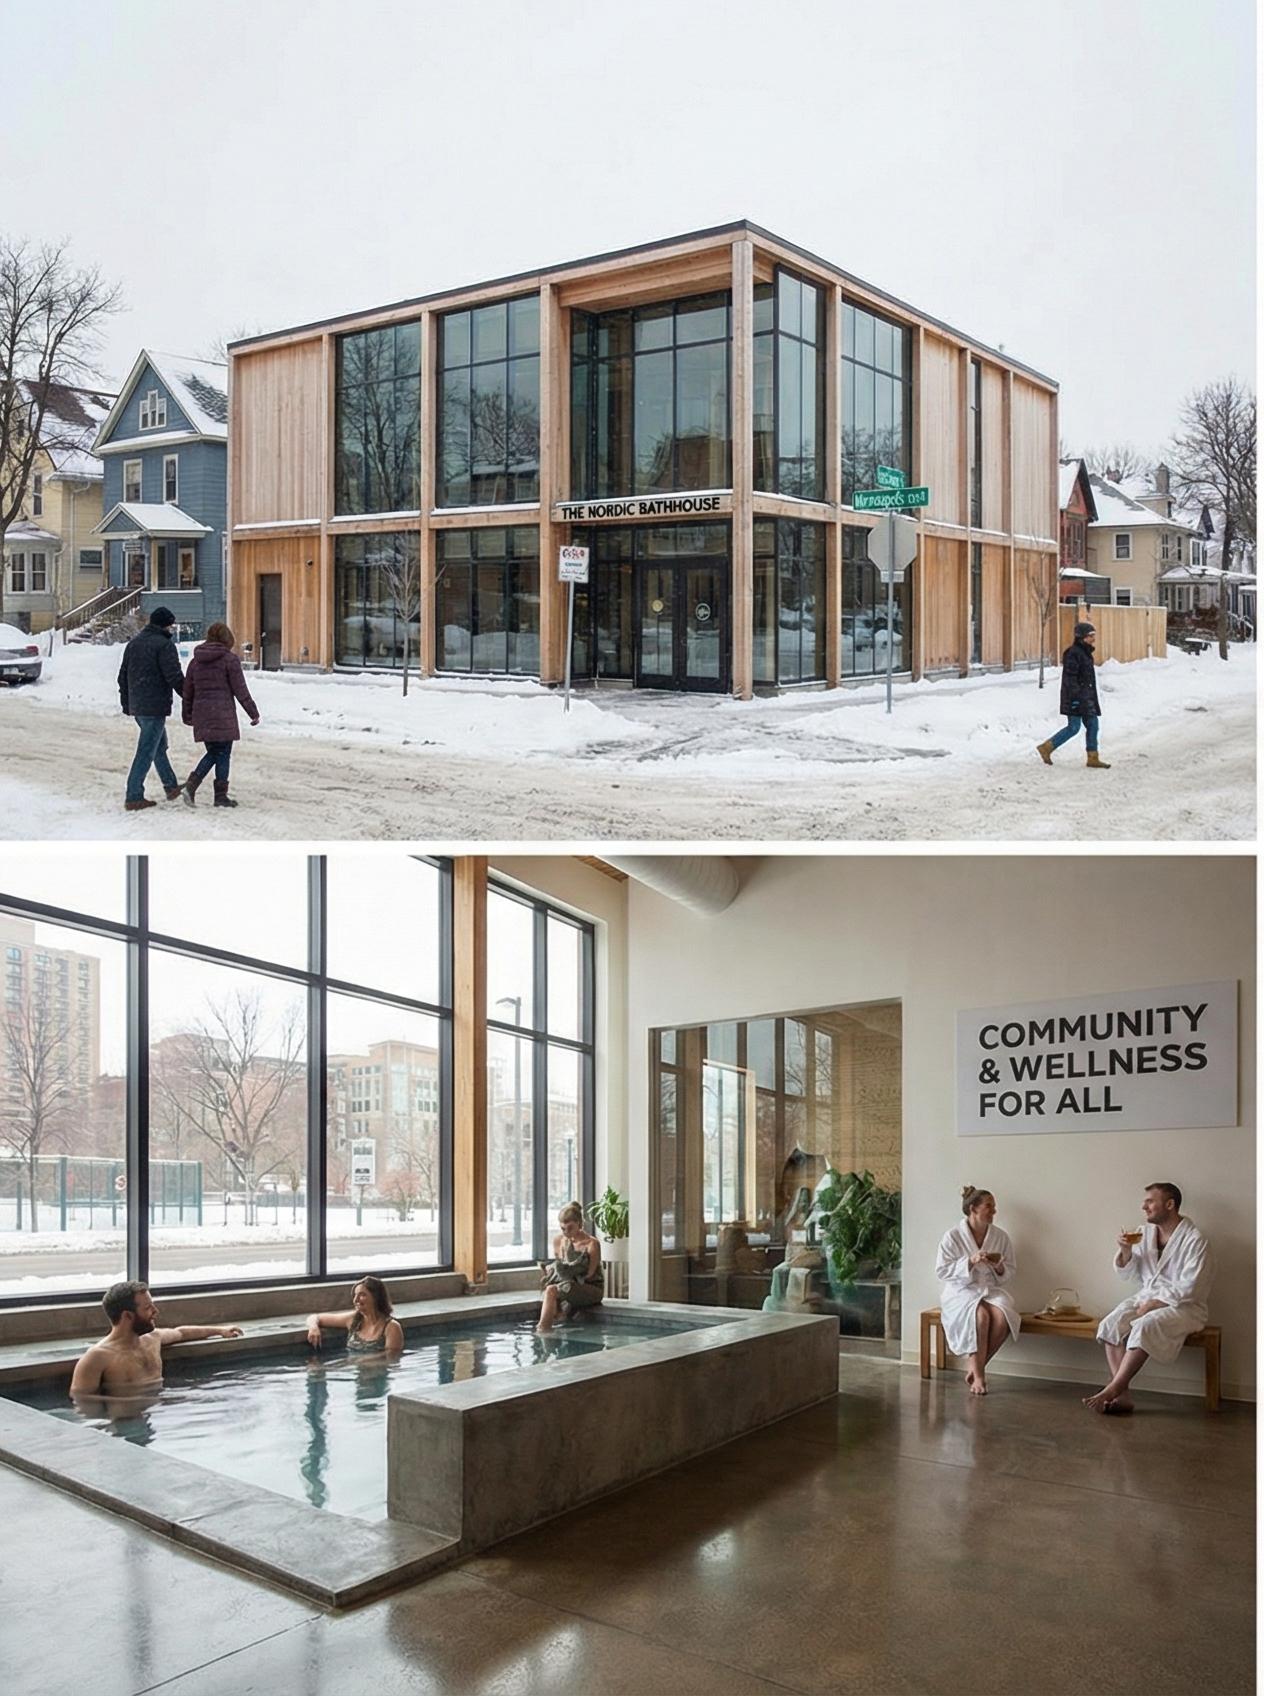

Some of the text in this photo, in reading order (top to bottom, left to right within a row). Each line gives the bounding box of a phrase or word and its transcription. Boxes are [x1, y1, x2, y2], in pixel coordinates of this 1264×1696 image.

[562, 497, 720, 520] THE NORDIC BATHHOUSE
[978, 1003, 1208, 1050] COMMUNITY
[978, 1042, 1208, 1084] & WELLNESS
[979, 1085, 1123, 1118] FOR ALL
